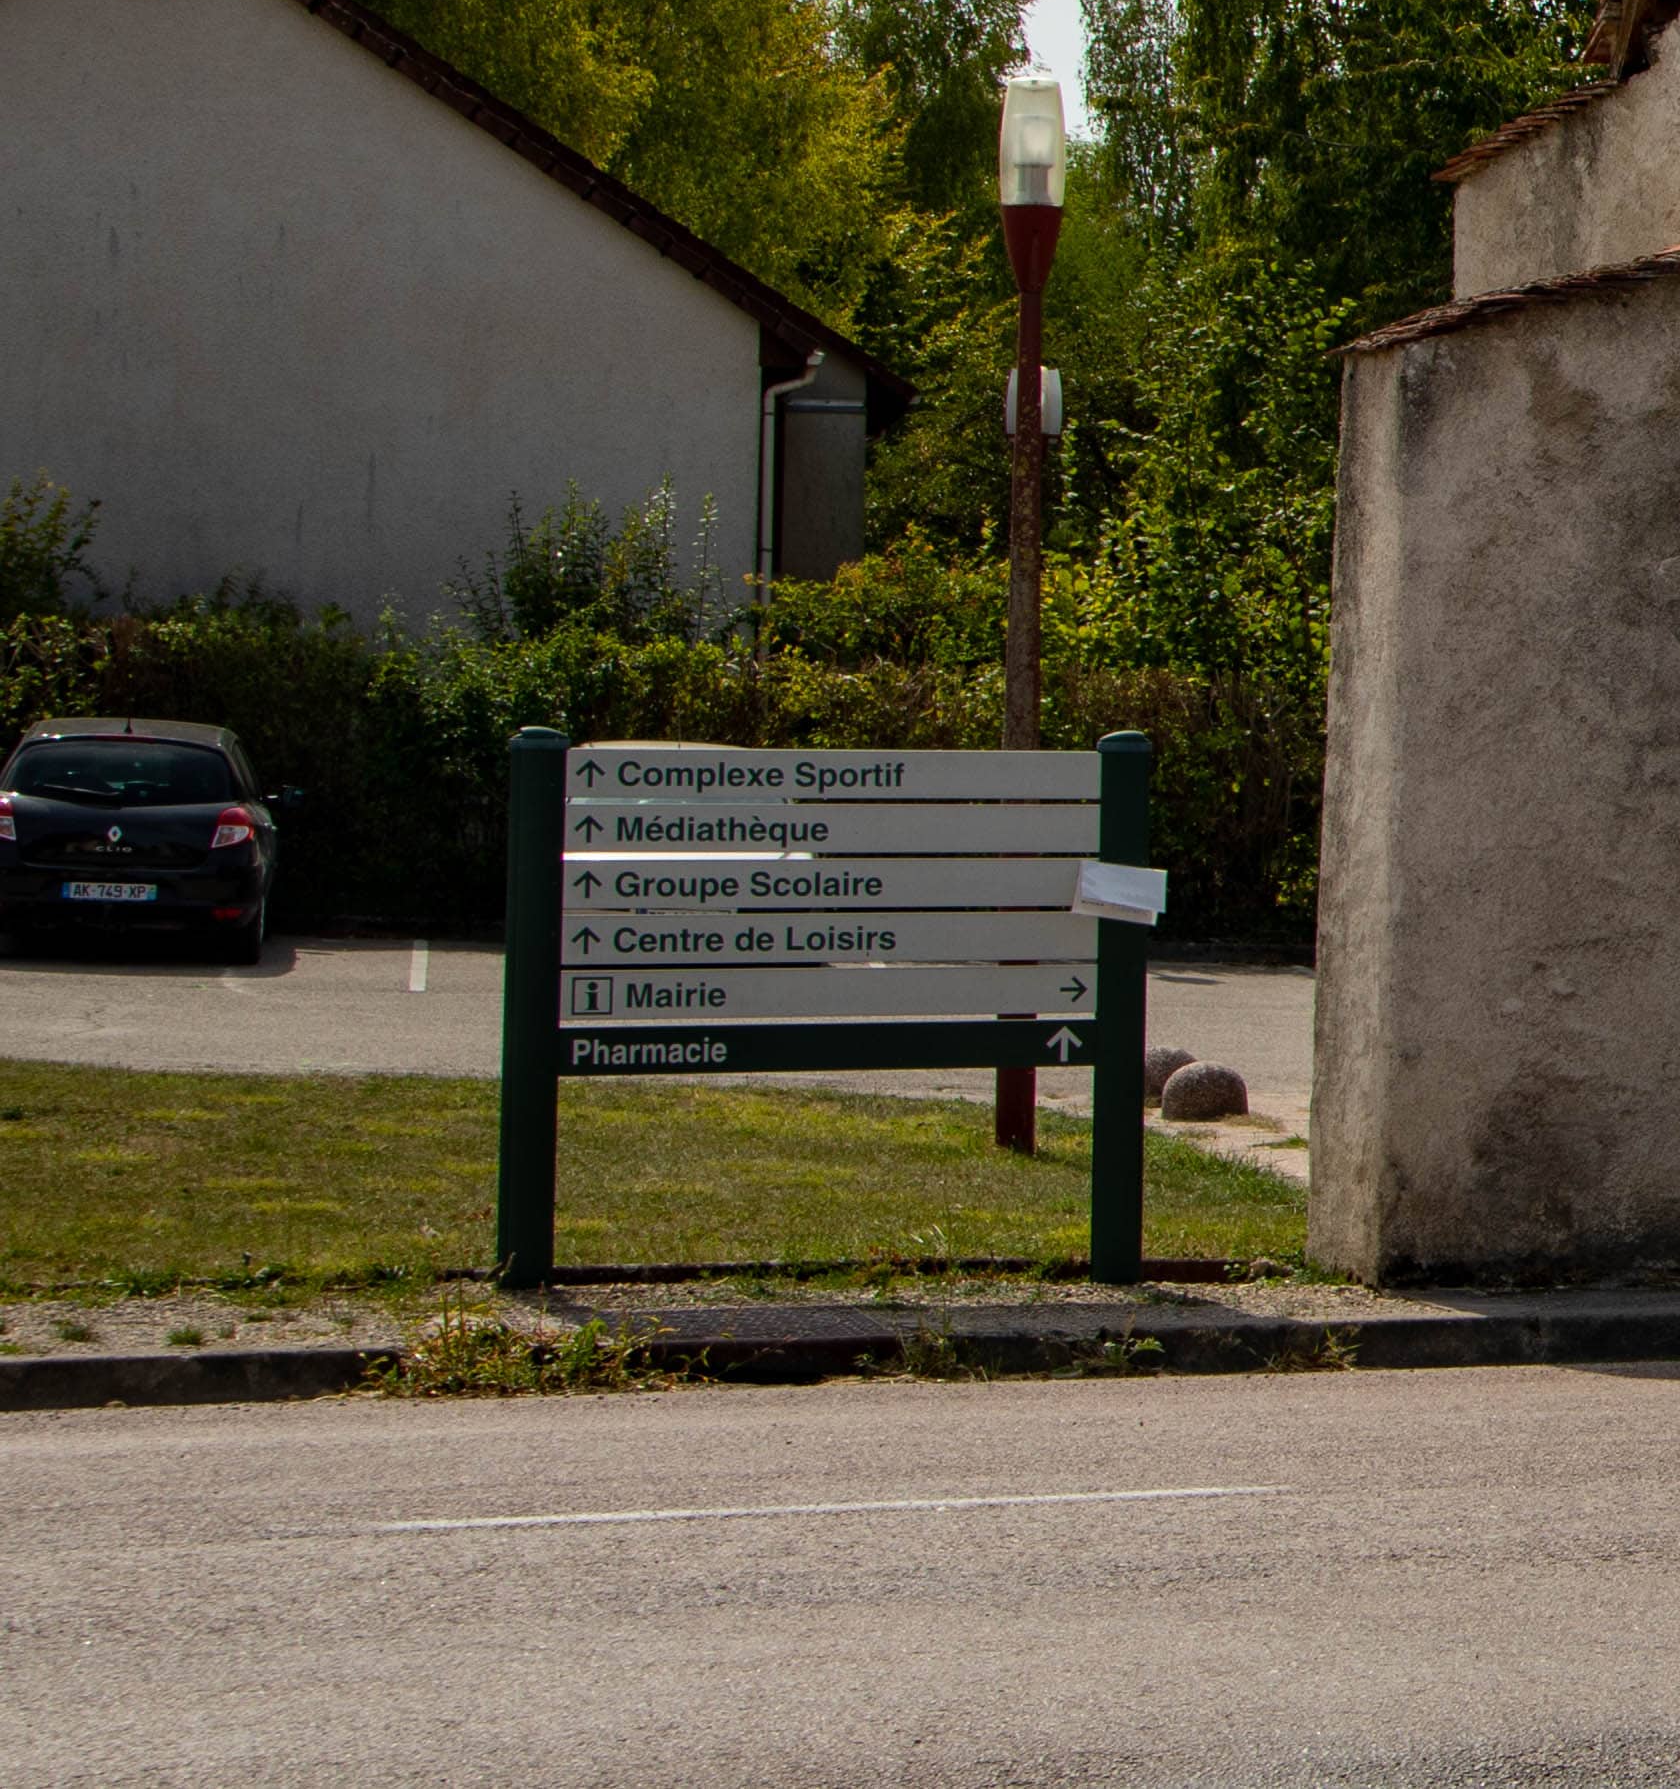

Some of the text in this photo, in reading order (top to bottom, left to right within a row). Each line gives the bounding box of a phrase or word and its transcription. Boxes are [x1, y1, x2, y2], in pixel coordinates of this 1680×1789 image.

[617, 761, 905, 793] Complexe Sportif
[616, 815, 829, 848] Médiathèque
[615, 871, 884, 903] Groupe Scolaire
[613, 924, 897, 953] Centre de Loisirs
[625, 981, 728, 1008] Mairie
[571, 1038, 728, 1066] Pharmacie
